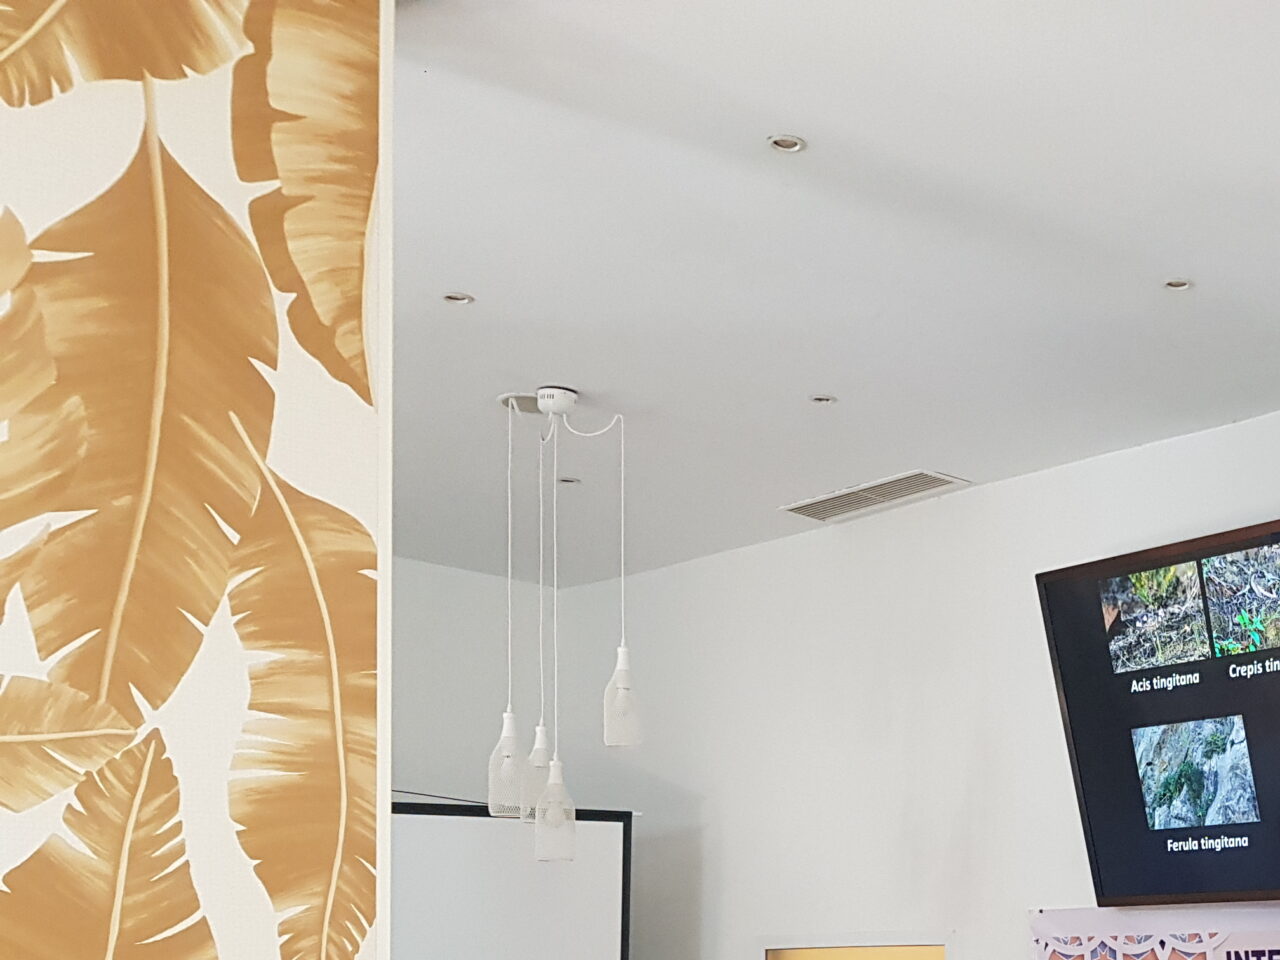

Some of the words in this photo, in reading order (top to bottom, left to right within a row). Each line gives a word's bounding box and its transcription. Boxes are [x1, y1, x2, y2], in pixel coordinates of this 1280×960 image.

[1228, 661, 1263, 679] Crepis
[1130, 677, 1150, 693] Acis
[1152, 671, 1200, 691] tingitana
[1167, 837, 1199, 852] Ferula
[1200, 835, 1249, 852] tingitana
